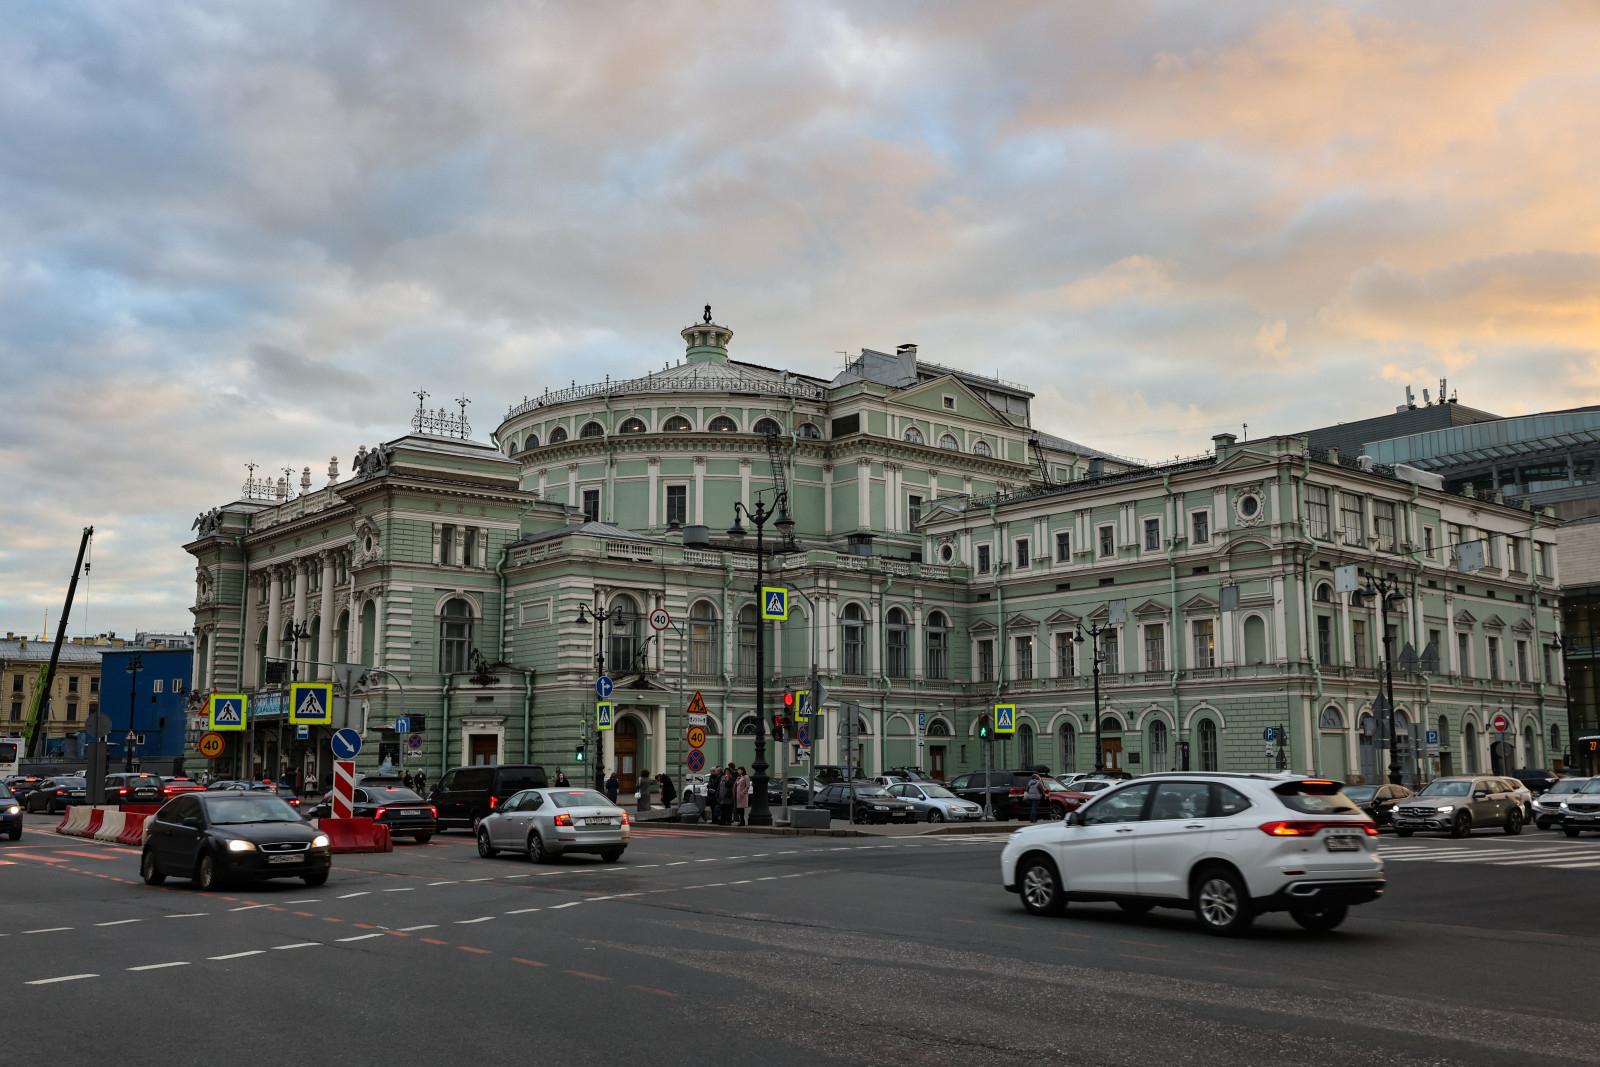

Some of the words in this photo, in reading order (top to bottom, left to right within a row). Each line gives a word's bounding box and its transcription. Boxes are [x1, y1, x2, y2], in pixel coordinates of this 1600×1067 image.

[654, 615, 666, 624] 40
[690, 733, 703, 742] 40
[1267, 728, 1273, 740] P
[1428, 732, 1436, 742] P
[204, 740, 219, 750] 40
[1589, 741, 1597, 751] 27
